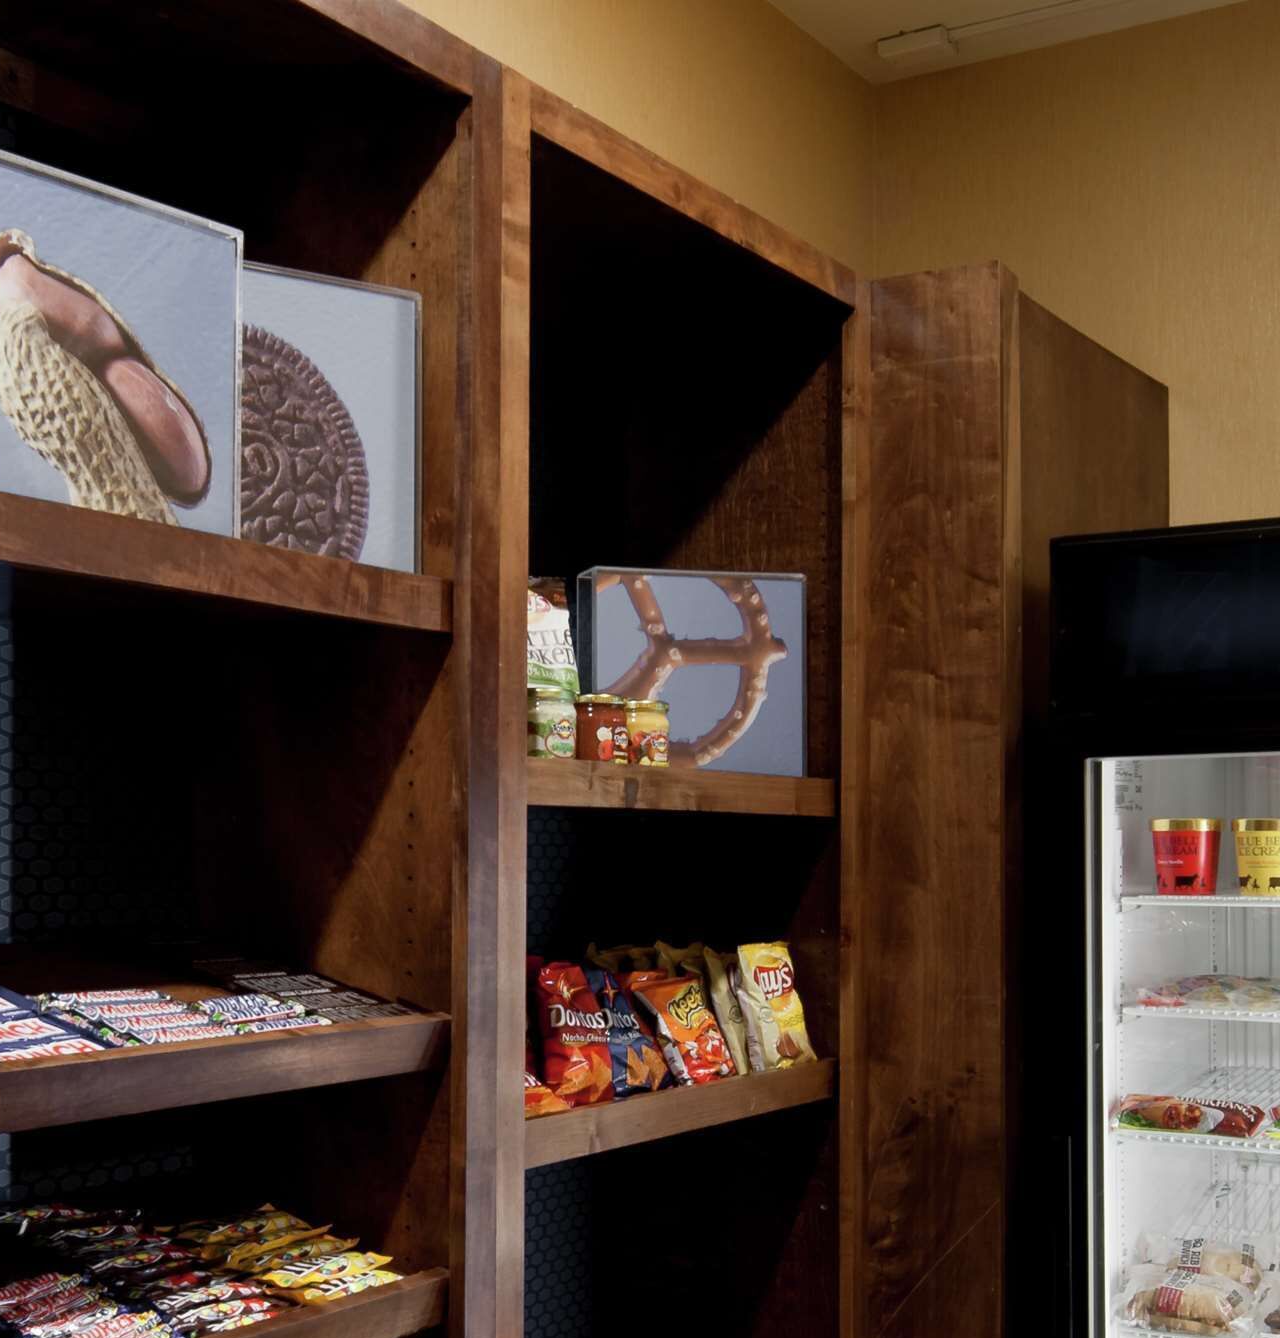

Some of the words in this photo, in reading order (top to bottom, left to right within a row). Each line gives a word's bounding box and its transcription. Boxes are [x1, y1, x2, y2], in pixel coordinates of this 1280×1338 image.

[256, 1016, 322, 1031] SNICKERS
[550, 1004, 604, 1029] Doritos
[562, 1032, 585, 1042] Nacho
